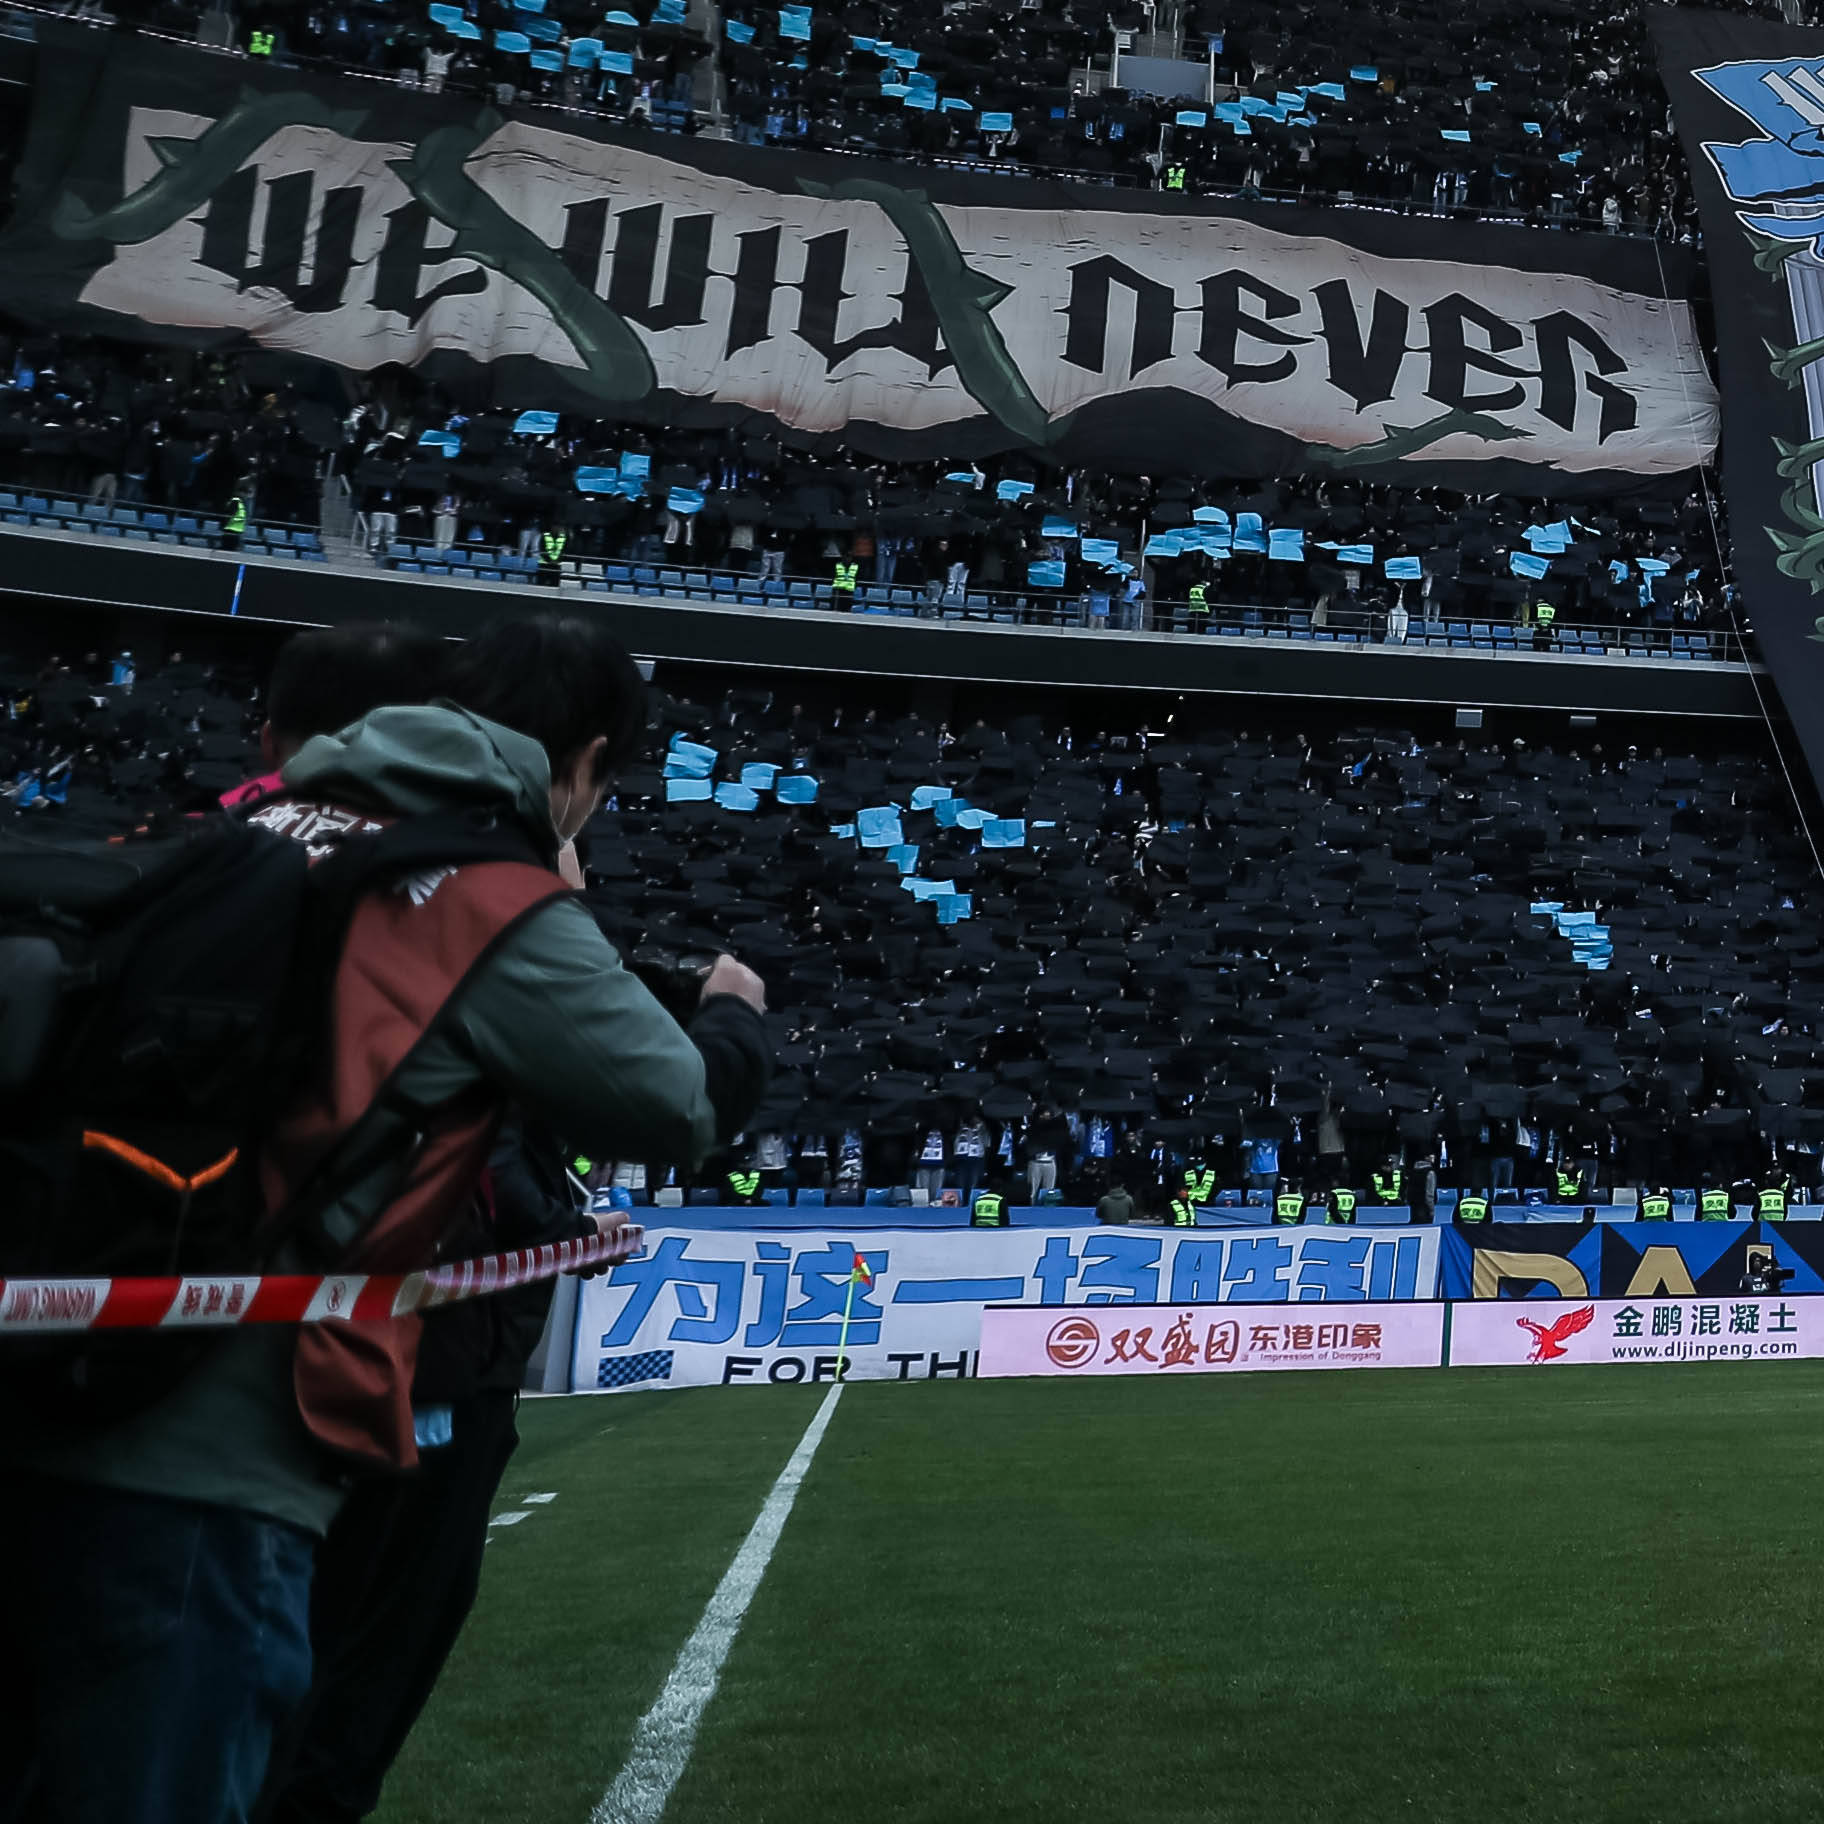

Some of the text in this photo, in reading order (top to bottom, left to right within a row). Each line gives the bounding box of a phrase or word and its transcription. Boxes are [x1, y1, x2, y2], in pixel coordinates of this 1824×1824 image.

[194, 160, 490, 328] WE
[1058, 254, 1640, 443] NEVER
[601, 1234, 1422, 1348] 为这一场胜利
[1612, 1302, 1798, 1338] 金鹏混凝土
[1104, 1312, 1241, 1370] 双盛园
[1249, 1322, 1383, 1352] 东港印象
[1612, 1340, 1798, 1362] www.dljinpeng.com
[721, 1355, 852, 1385] FOR
[1261, 1350, 1382, 1363] Impression of Donggang
